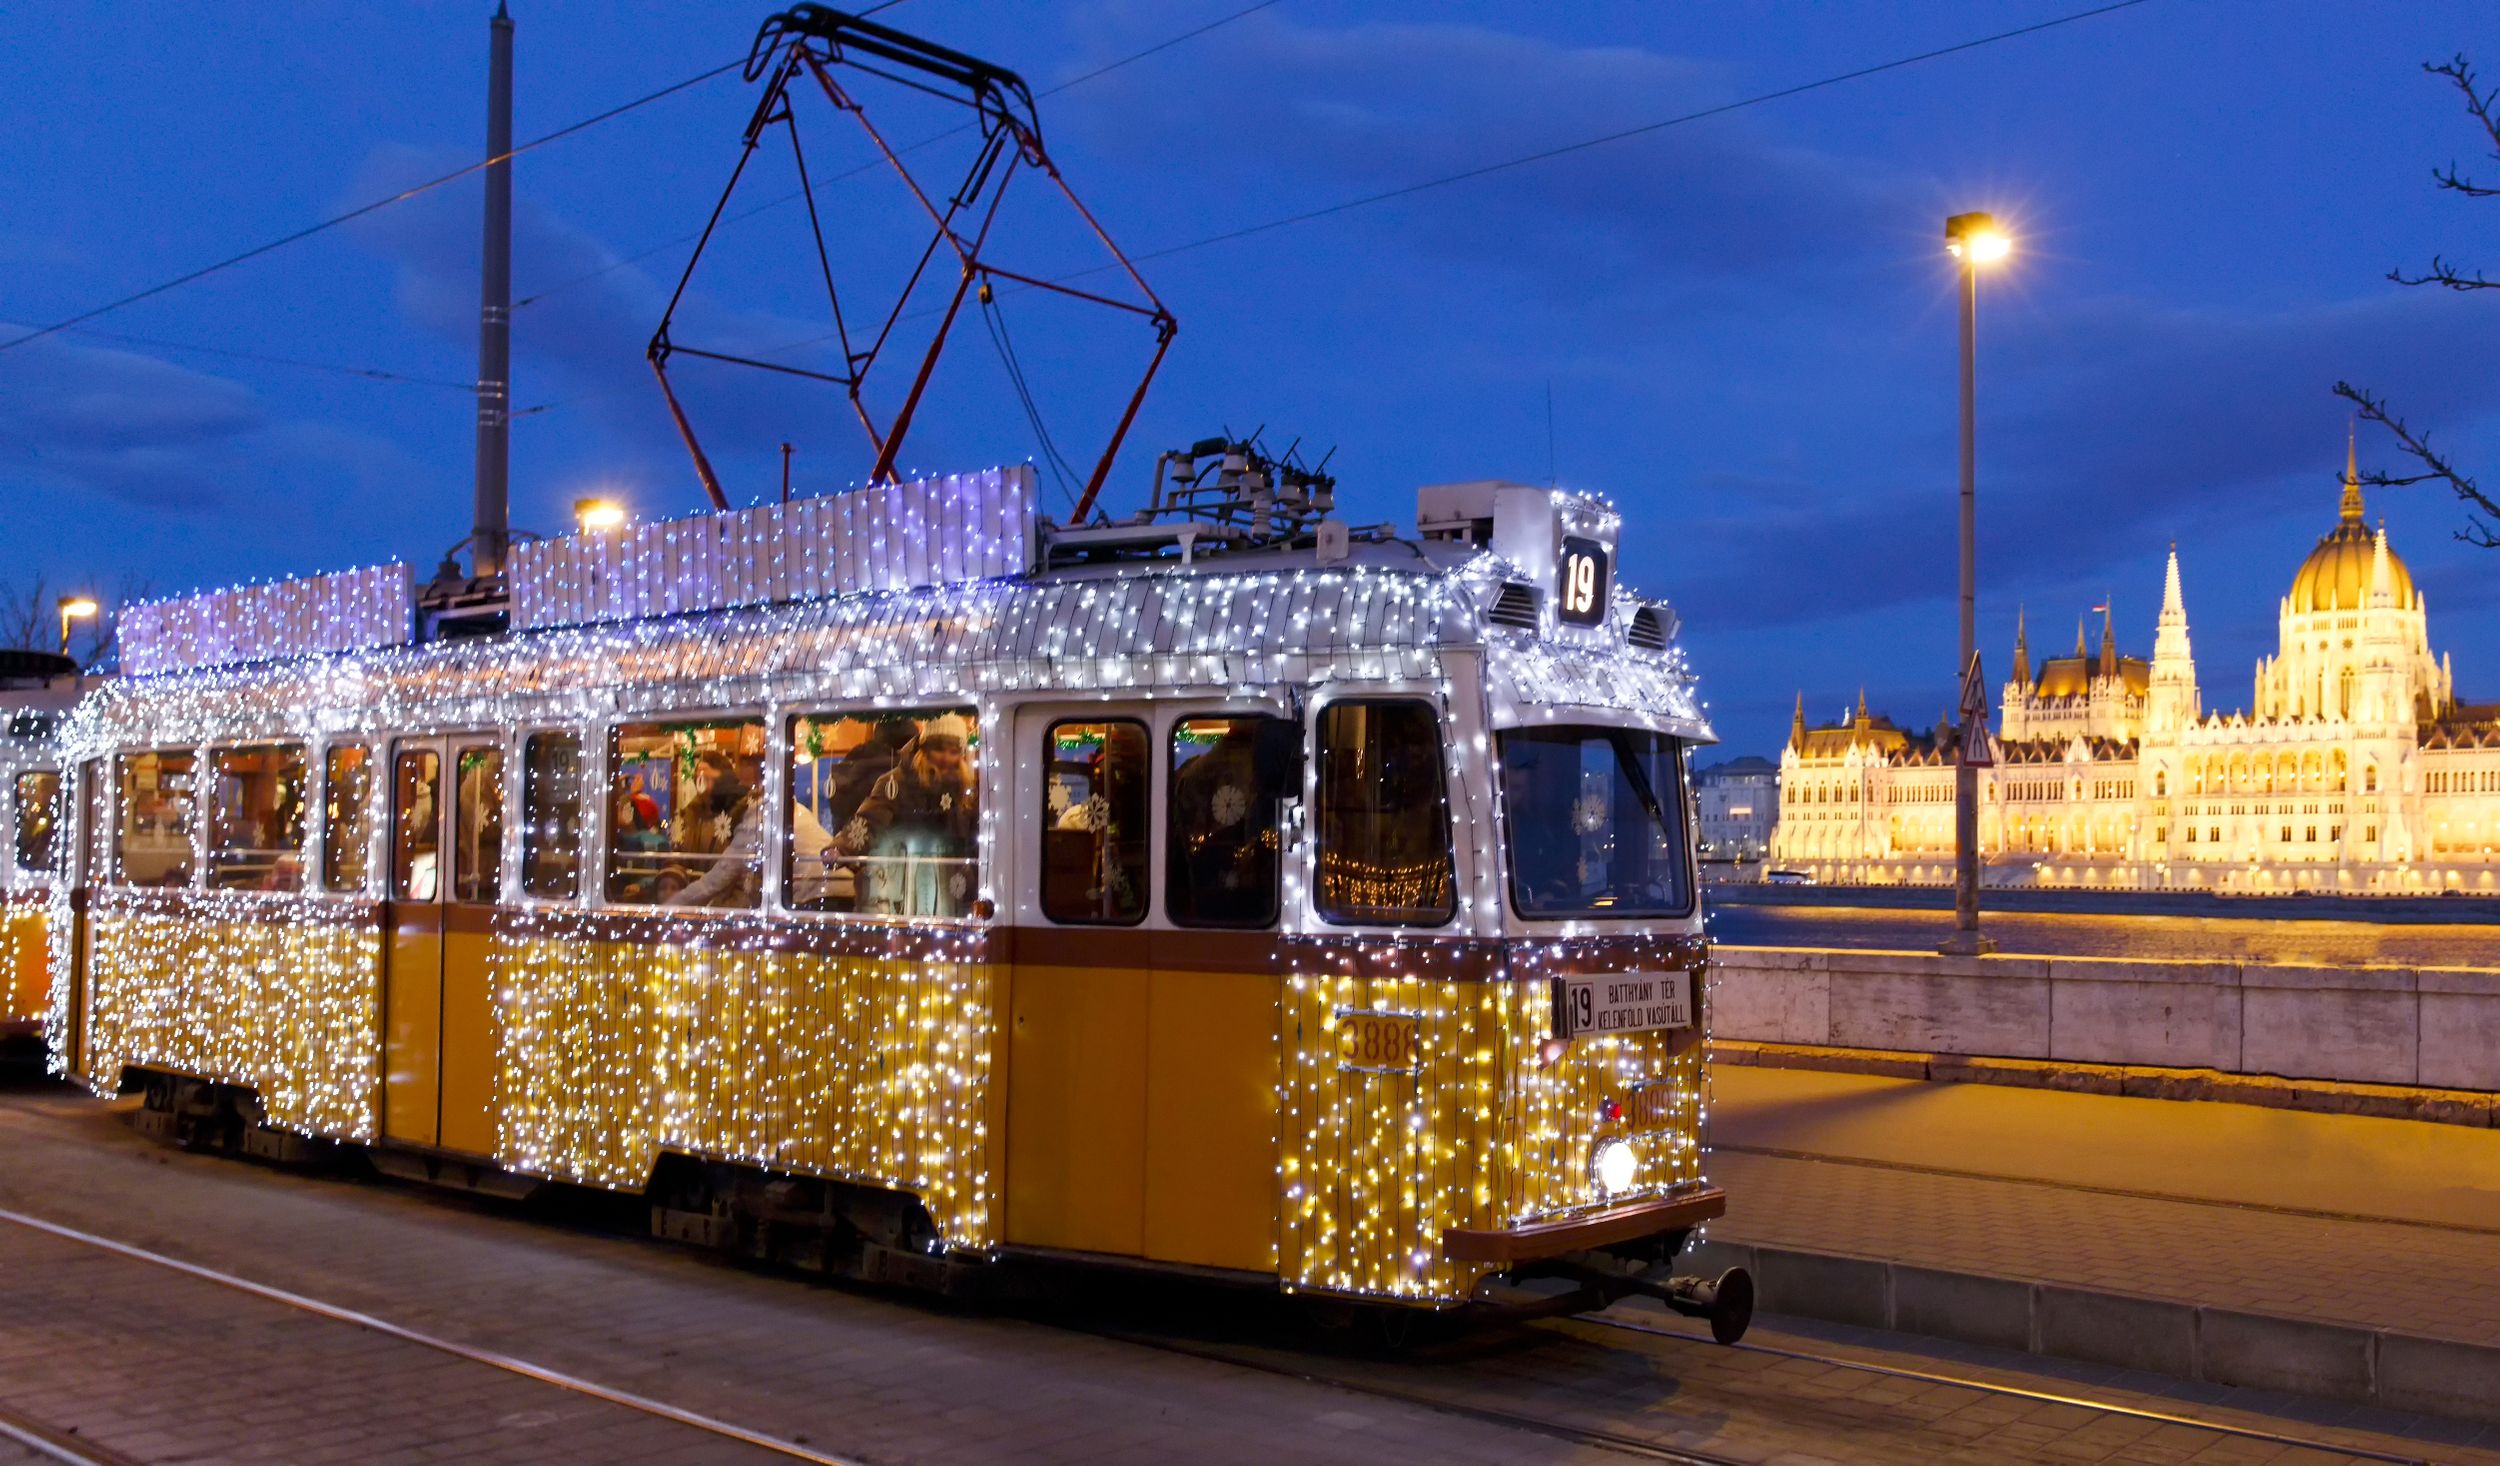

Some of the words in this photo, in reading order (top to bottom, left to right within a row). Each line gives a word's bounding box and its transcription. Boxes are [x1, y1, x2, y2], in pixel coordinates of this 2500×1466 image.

[1566, 553, 1595, 613] 19
[1571, 987, 1592, 1028] 19
[1608, 979, 1654, 1004] BATTHYÁNY
[1660, 977, 1676, 1000] TÉR
